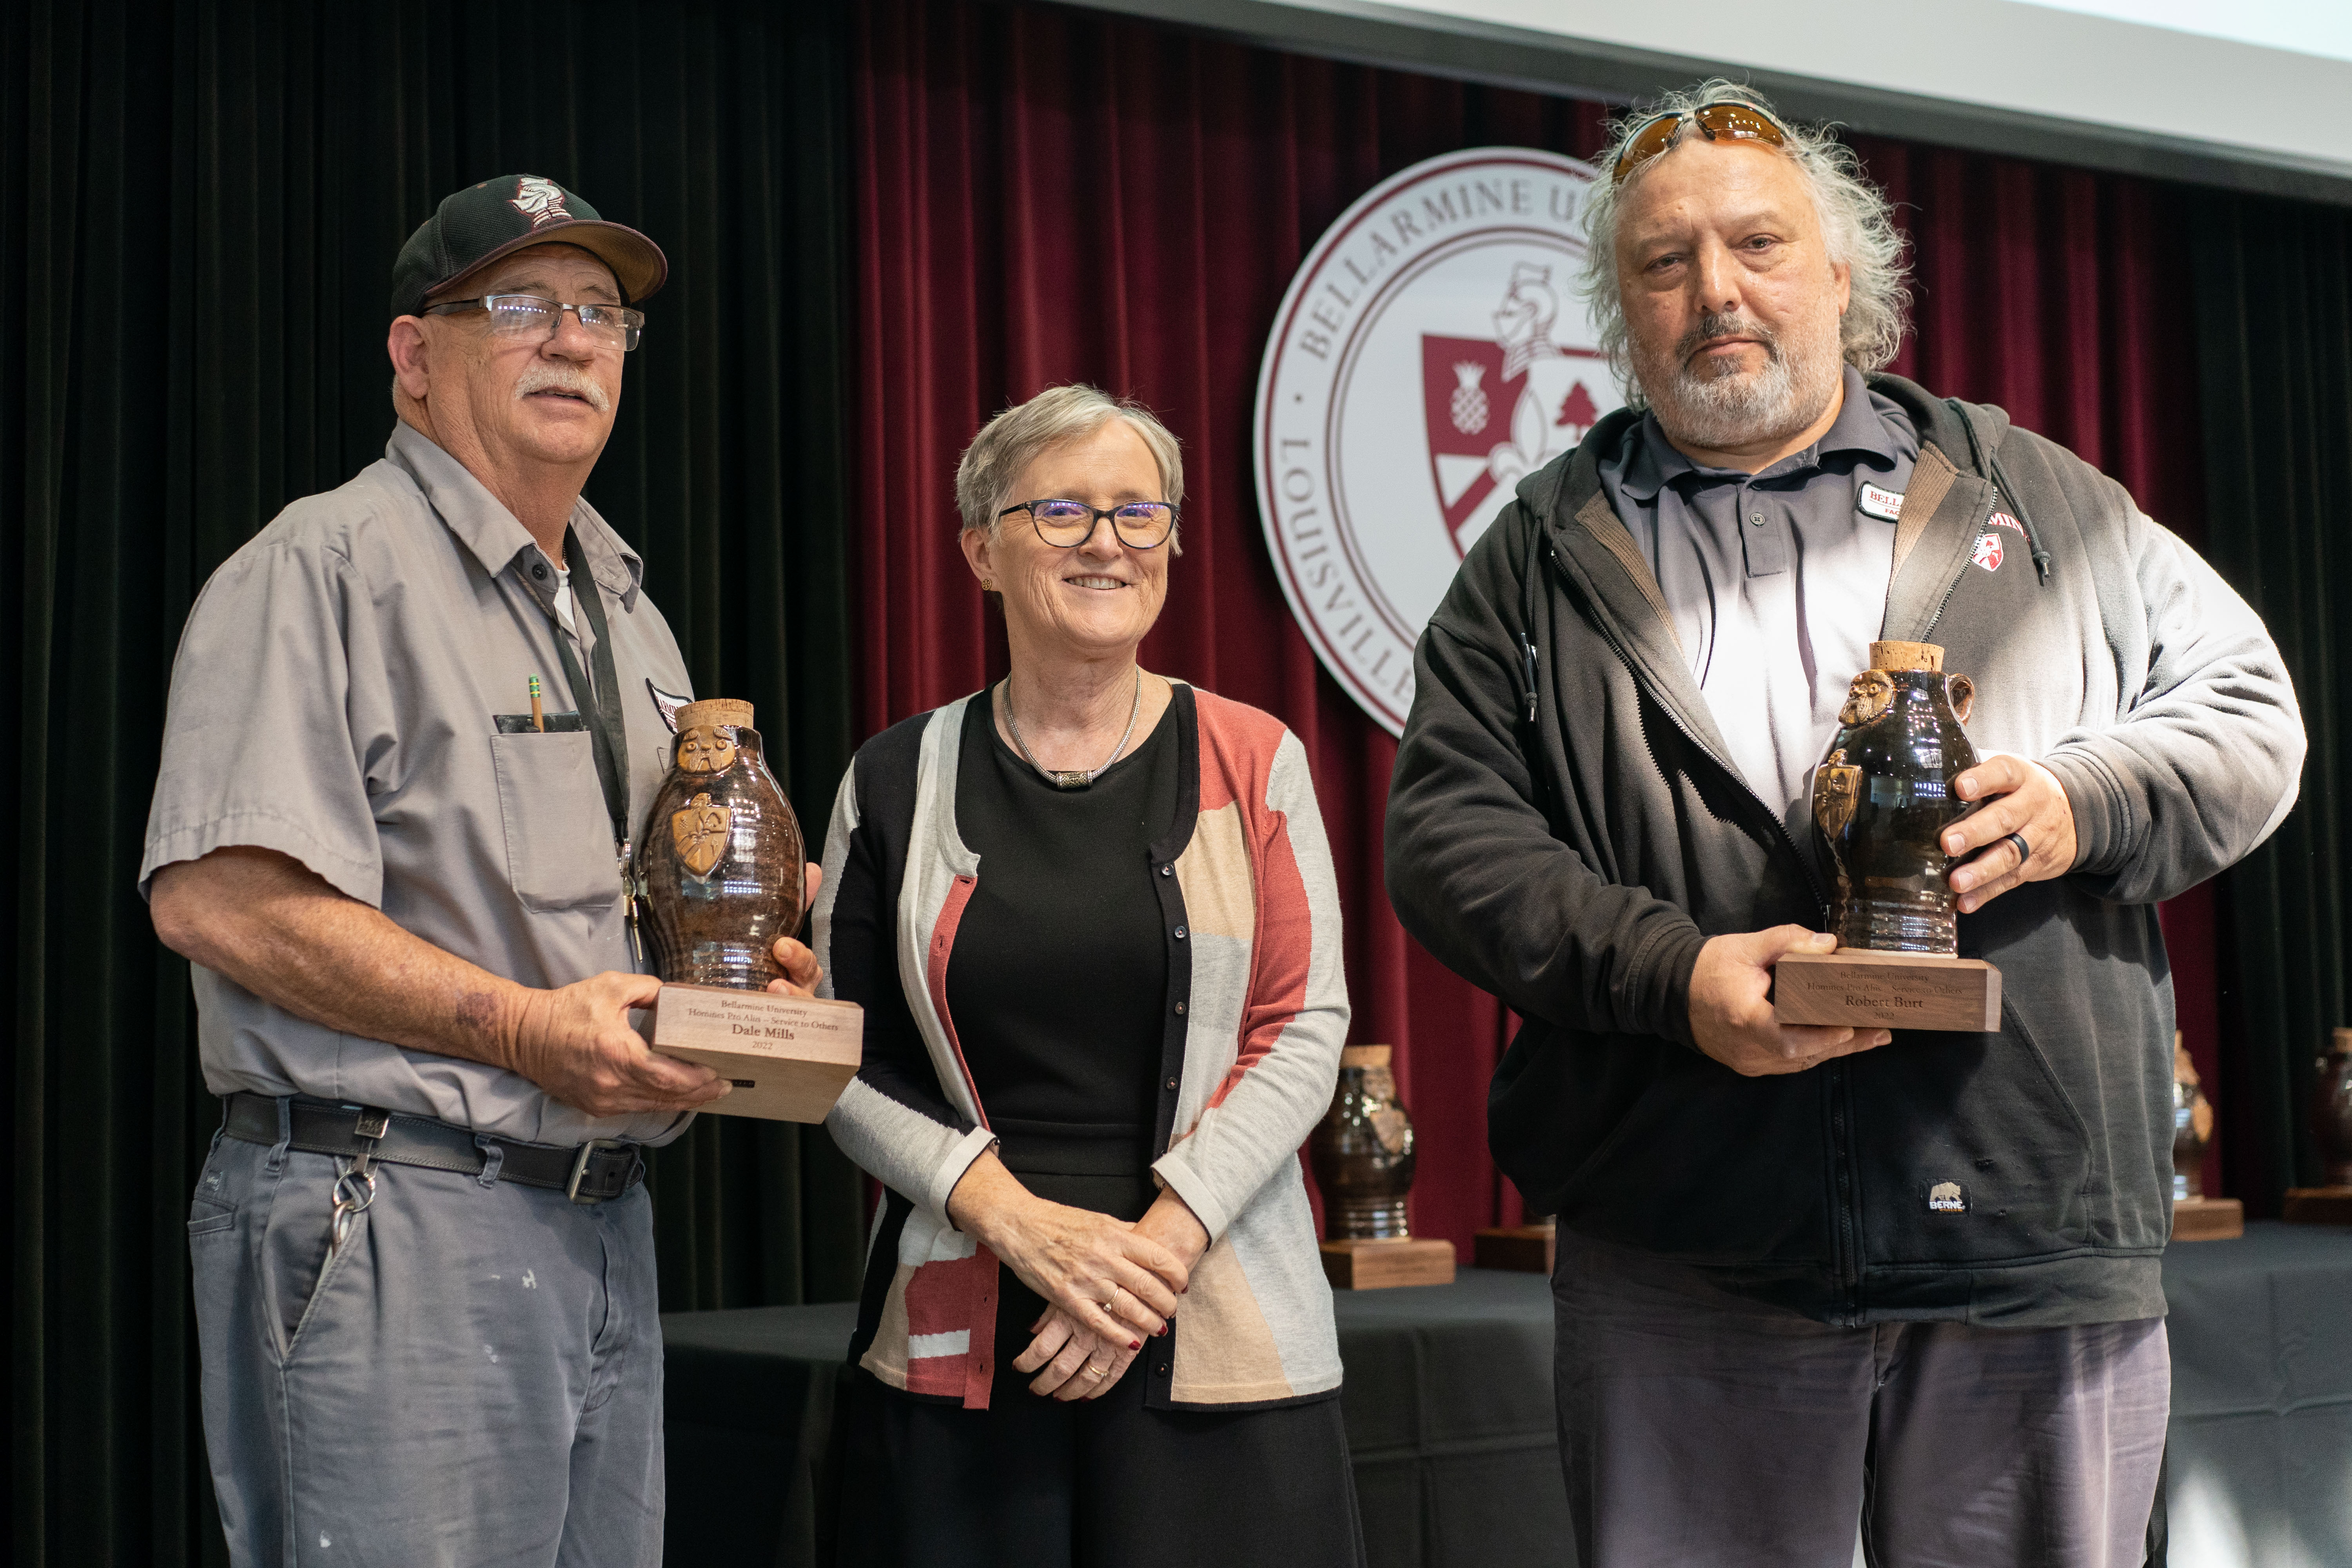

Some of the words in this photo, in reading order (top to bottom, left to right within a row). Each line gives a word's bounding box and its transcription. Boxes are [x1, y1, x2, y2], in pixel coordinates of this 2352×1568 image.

[1299, 178, 1534, 363] BELLARMINE
[1549, 185, 1576, 222] U
[1870, 490, 1900, 506] BELL
[1988, 512, 2025, 537] MIN
[1281, 437, 1414, 706] LOUISVILLE
[1840, 971, 1883, 980] Bellarmine
[1887, 972, 1929, 983] University
[1808, 982, 1843, 991] Homines
[1892, 985, 1921, 994] Service
[1934, 984, 1962, 994] Others
[722, 1000, 764, 1012] Bellarmine
[767, 1005, 808, 1018] University
[1846, 995, 1889, 1007] Robert
[1894, 996, 1924, 1008] Burt
[688, 1008, 725, 1019] Homines
[771, 1017, 799, 1027] Service
[811, 1020, 838, 1031] Others
[732, 1023, 761, 1036] Dale
[765, 1027, 795, 1040] Mills
[752, 1040, 773, 1050] 2022
[1929, 1201, 1963, 1209] BERNE
